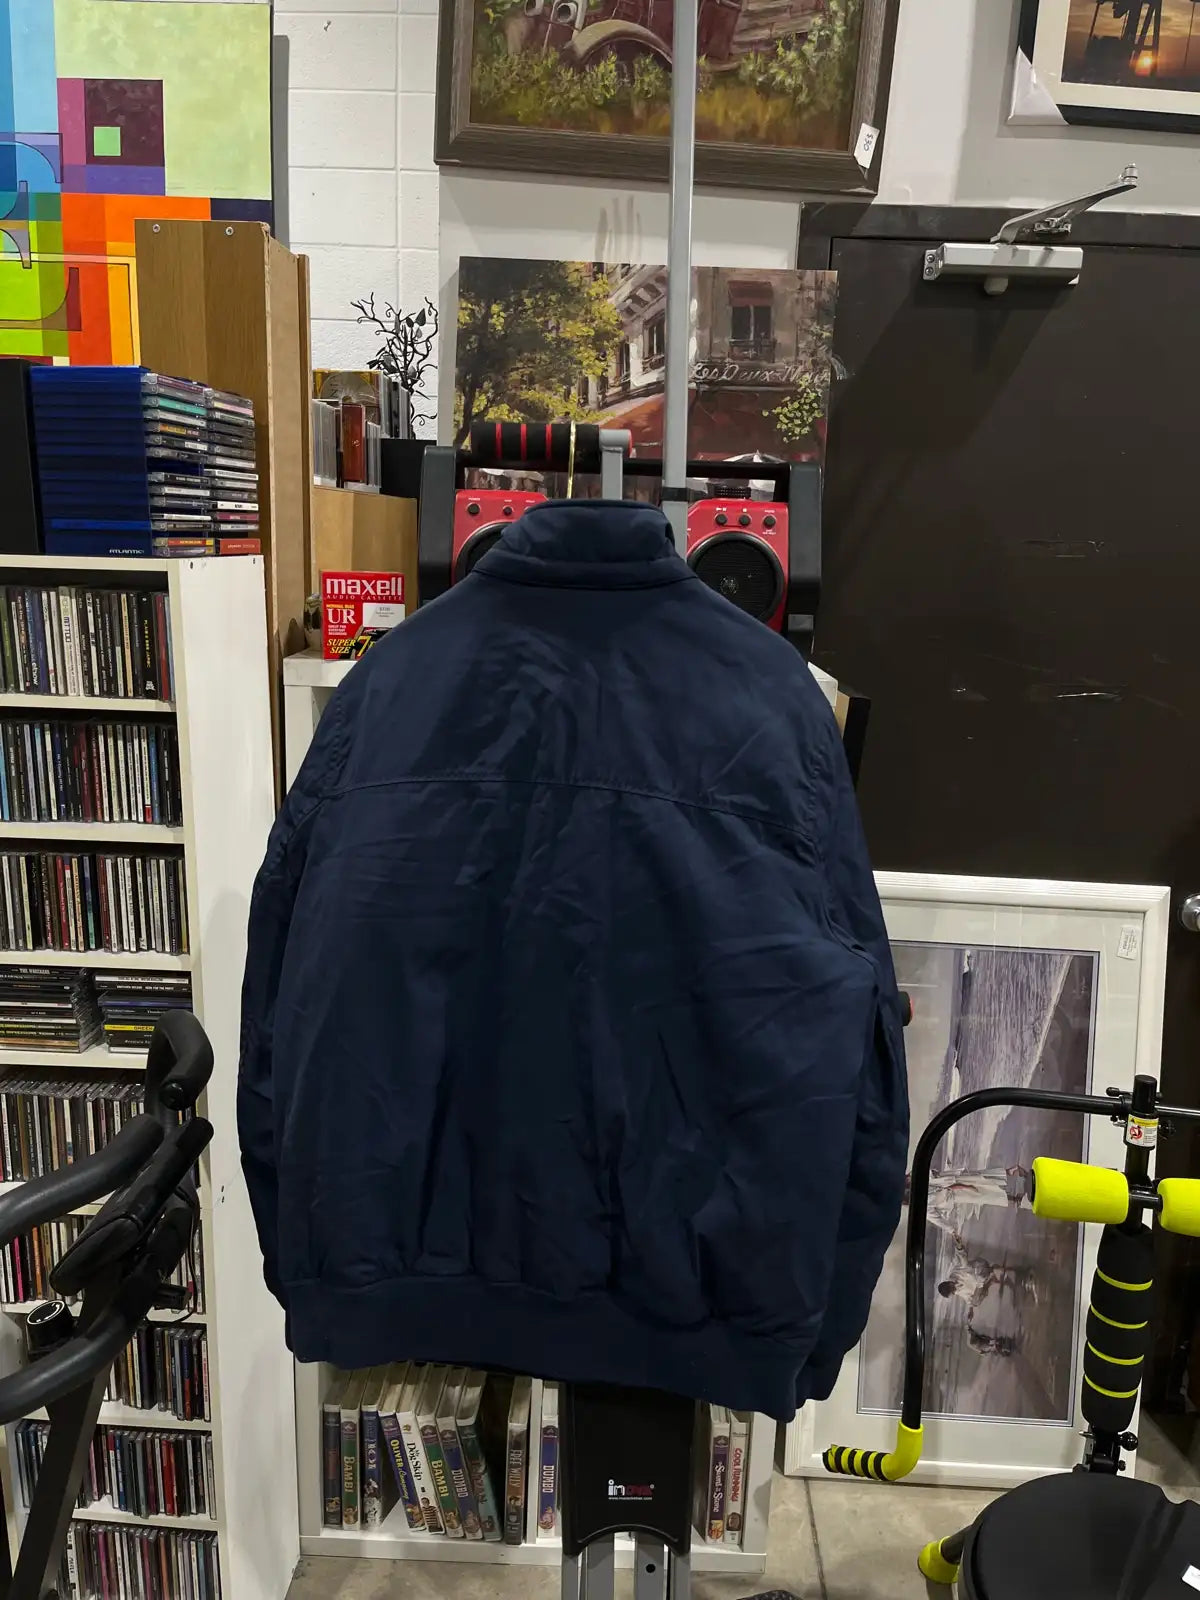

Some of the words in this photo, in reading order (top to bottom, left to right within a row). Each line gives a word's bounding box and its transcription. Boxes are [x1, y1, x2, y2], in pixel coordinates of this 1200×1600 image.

[326, 577, 402, 595] maxell
[327, 608, 356, 624] UR
[330, 646, 351, 654] SIZE
[390, 1439, 404, 1468] OLIVER
[407, 1442, 417, 1461] Dog
[509, 1449, 522, 1465] FREE
[343, 1456, 355, 1493] BAMBI
[411, 1461, 423, 1481] Skip
[431, 1460, 449, 1497] BAMBI
[542, 1465, 554, 1493] DUMBO
[451, 1469, 469, 1498] DUMBO
